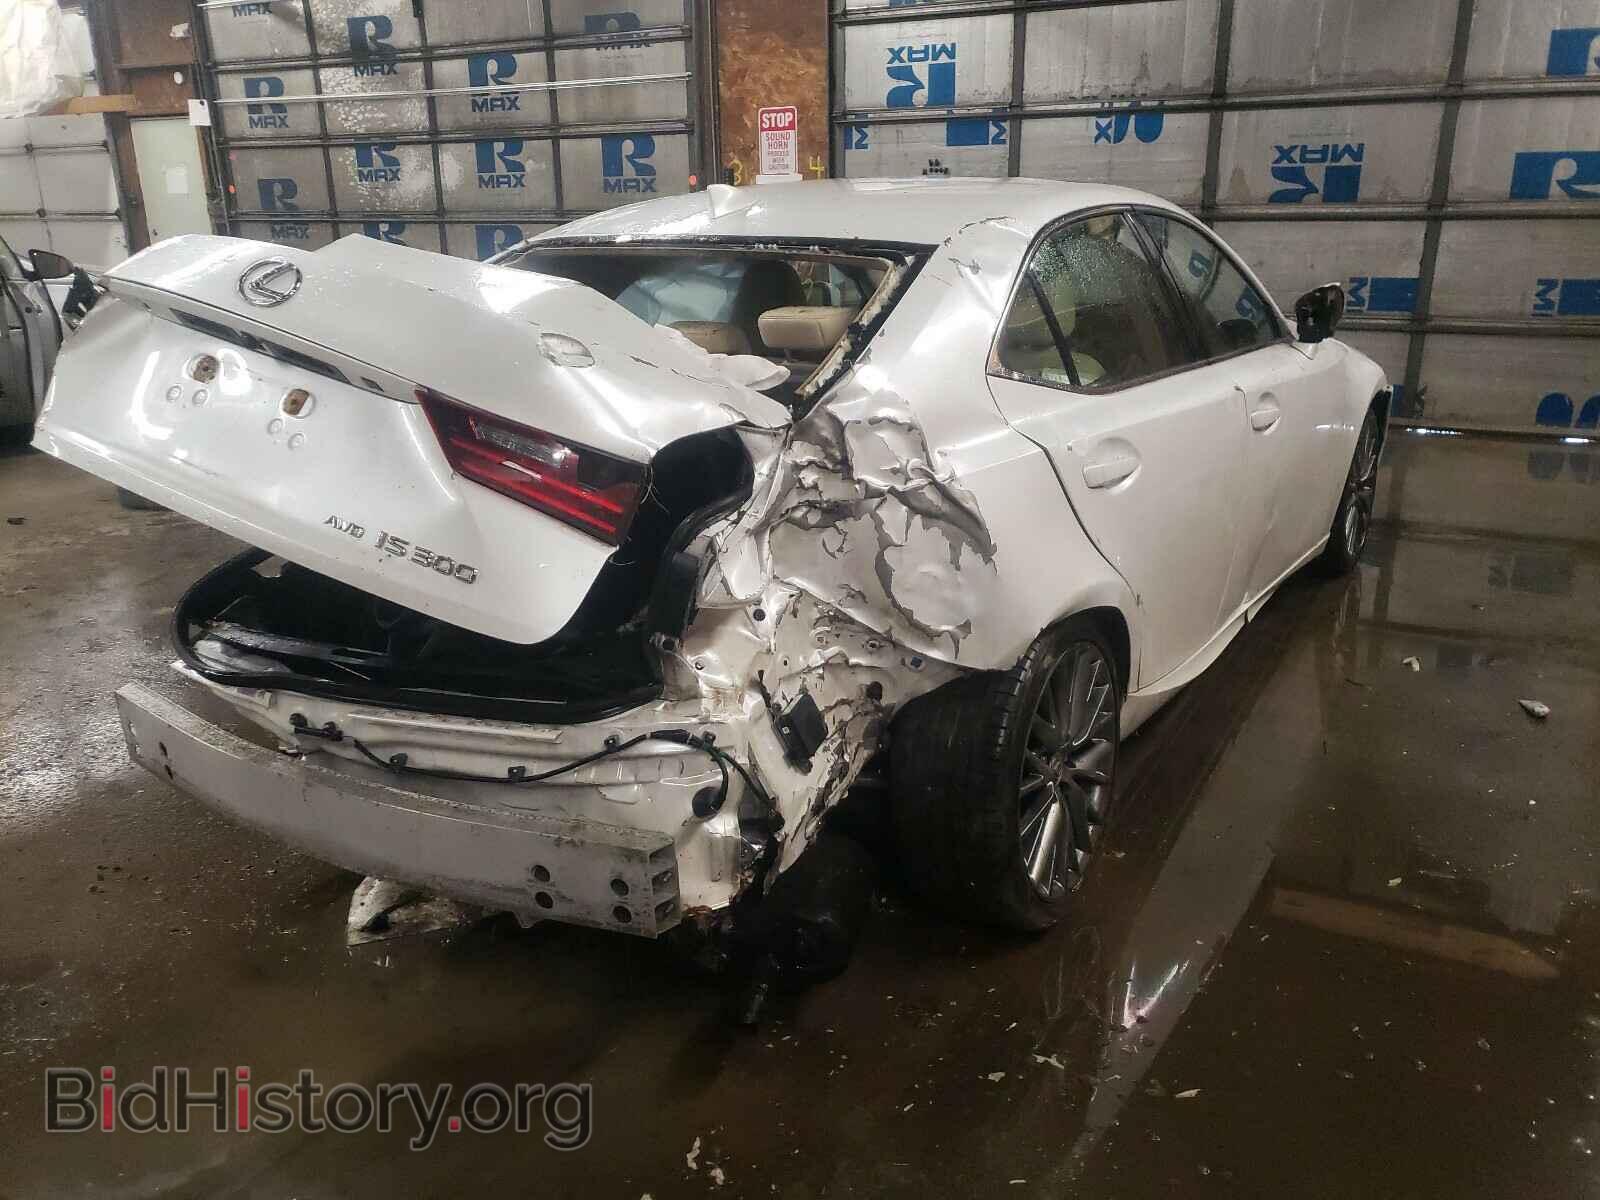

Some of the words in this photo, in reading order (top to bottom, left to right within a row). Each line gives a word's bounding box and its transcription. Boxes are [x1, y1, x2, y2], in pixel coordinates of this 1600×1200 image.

[886, 42, 957, 64] MAX
[353, 62, 399, 77] MAX
[471, 96, 521, 112] MAX
[249, 115, 290, 129] MAX
[761, 111, 794, 129] STOP
[765, 131, 791, 141] SOUND
[768, 141, 789, 150] HORN
[601, 134, 656, 176] R
[1271, 144, 1365, 164] MAX
[809, 154, 825, 179] 4
[358, 168, 401, 183] MAX
[478, 174, 526, 189] MAX
[603, 177, 658, 193] MAX
[270, 223, 310, 240] MAX
[323, 515, 365, 539] AWD
[411, 545, 480, 585] 300
